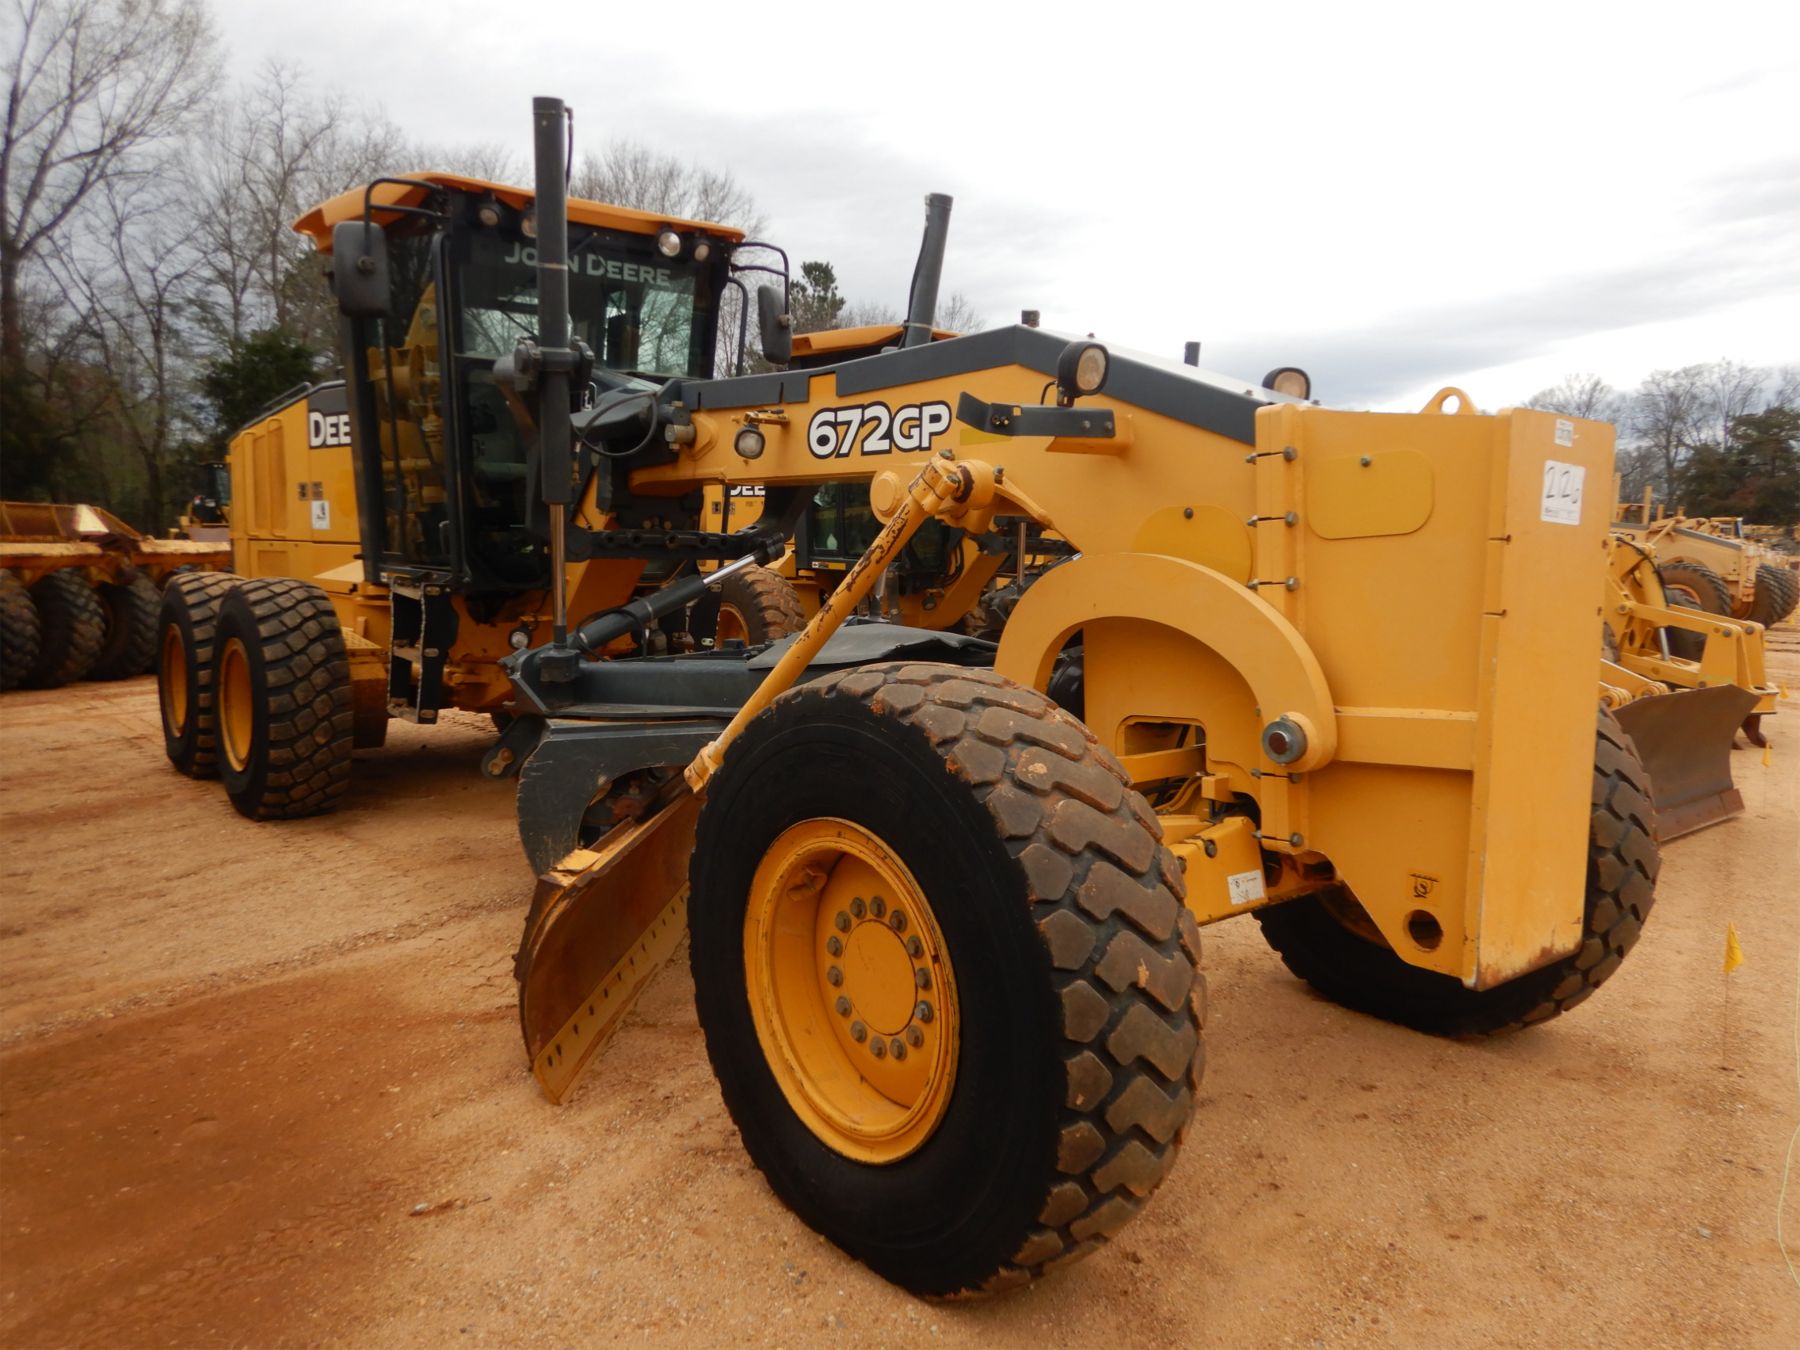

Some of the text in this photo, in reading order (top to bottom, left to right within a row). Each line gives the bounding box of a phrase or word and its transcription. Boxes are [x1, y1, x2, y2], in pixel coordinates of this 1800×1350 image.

[504, 242, 671, 287] JON DEERE
[309, 410, 351, 448] DEE
[808, 401, 952, 459] 672GP
